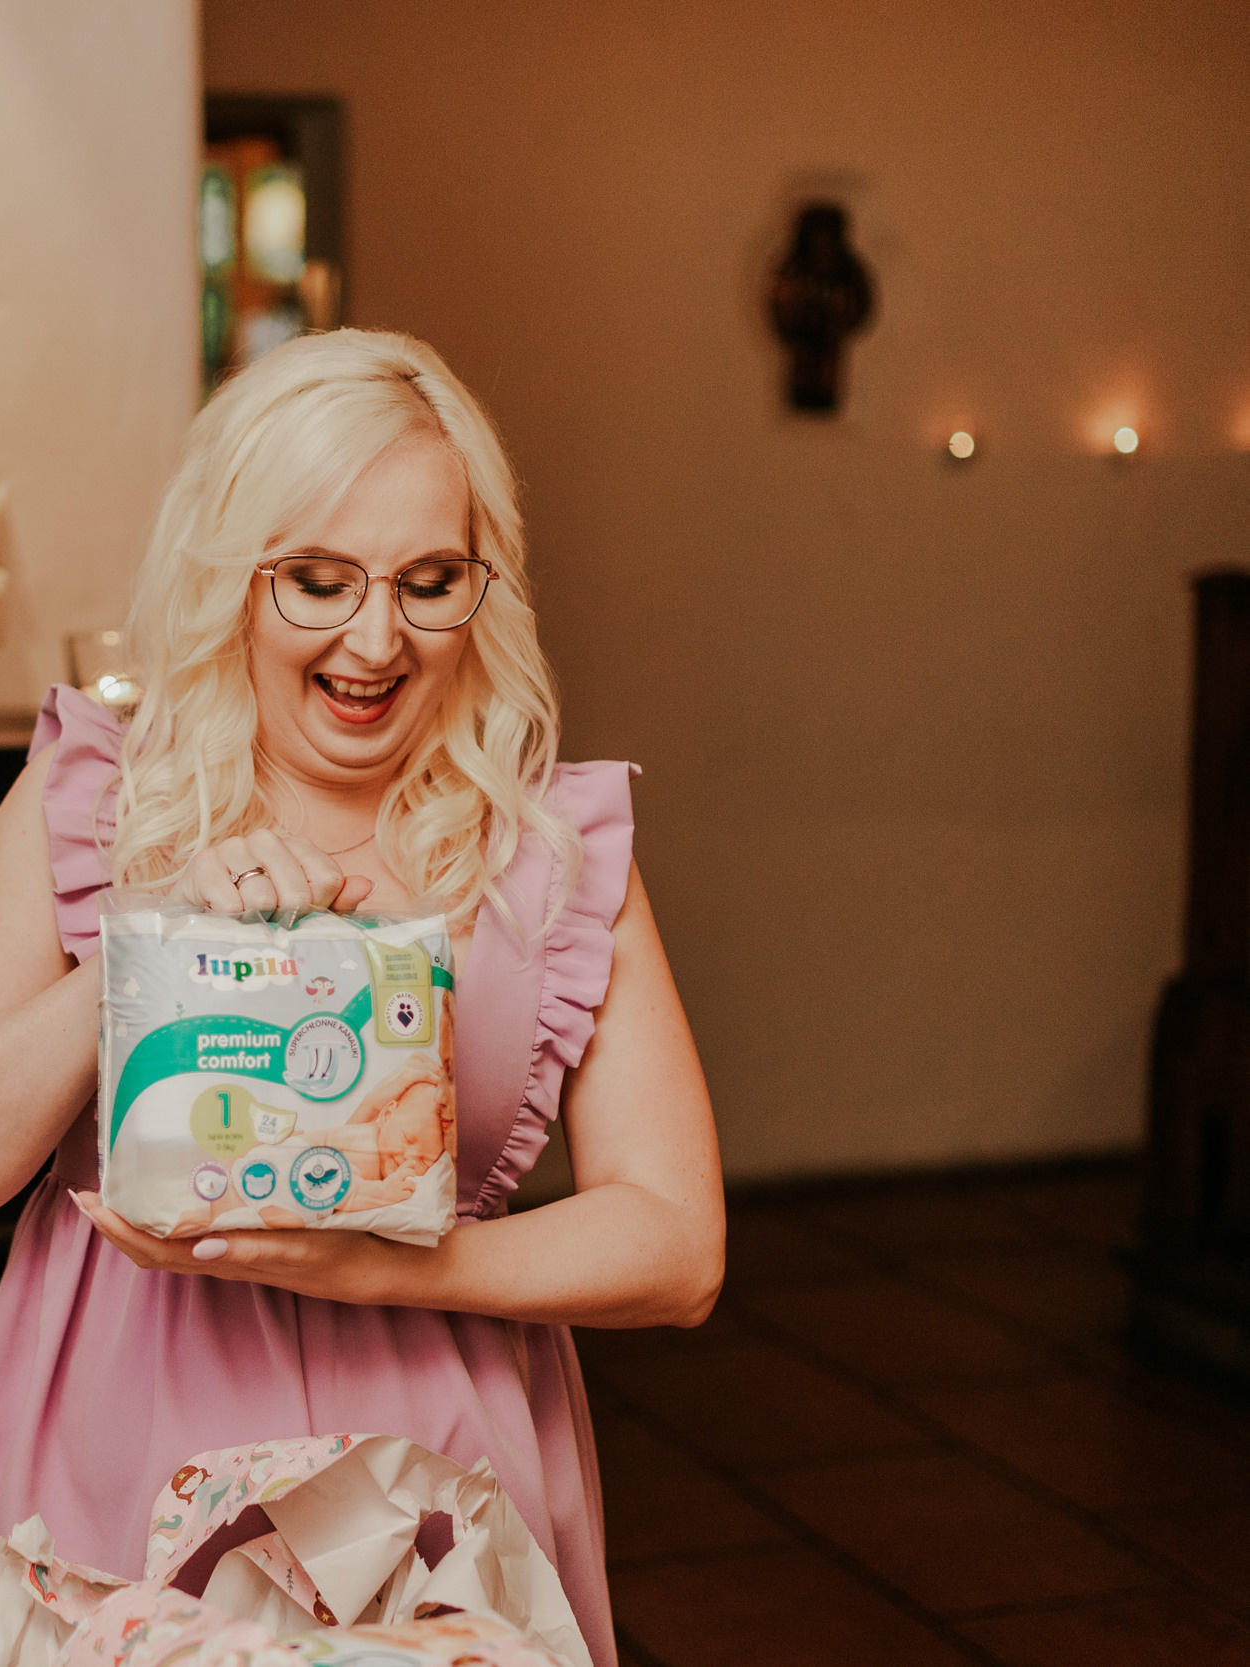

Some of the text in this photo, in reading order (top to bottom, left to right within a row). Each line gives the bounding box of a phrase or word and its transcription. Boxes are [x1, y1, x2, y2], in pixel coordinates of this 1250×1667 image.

[196, 953, 299, 982] lupilu
[197, 1030, 281, 1052] premium
[288, 1019, 359, 1059] SUPERCHŁONNE KANALIKI
[197, 1050, 271, 1069] comfort
[216, 1090, 231, 1128] 1
[261, 1114, 278, 1127] 24
